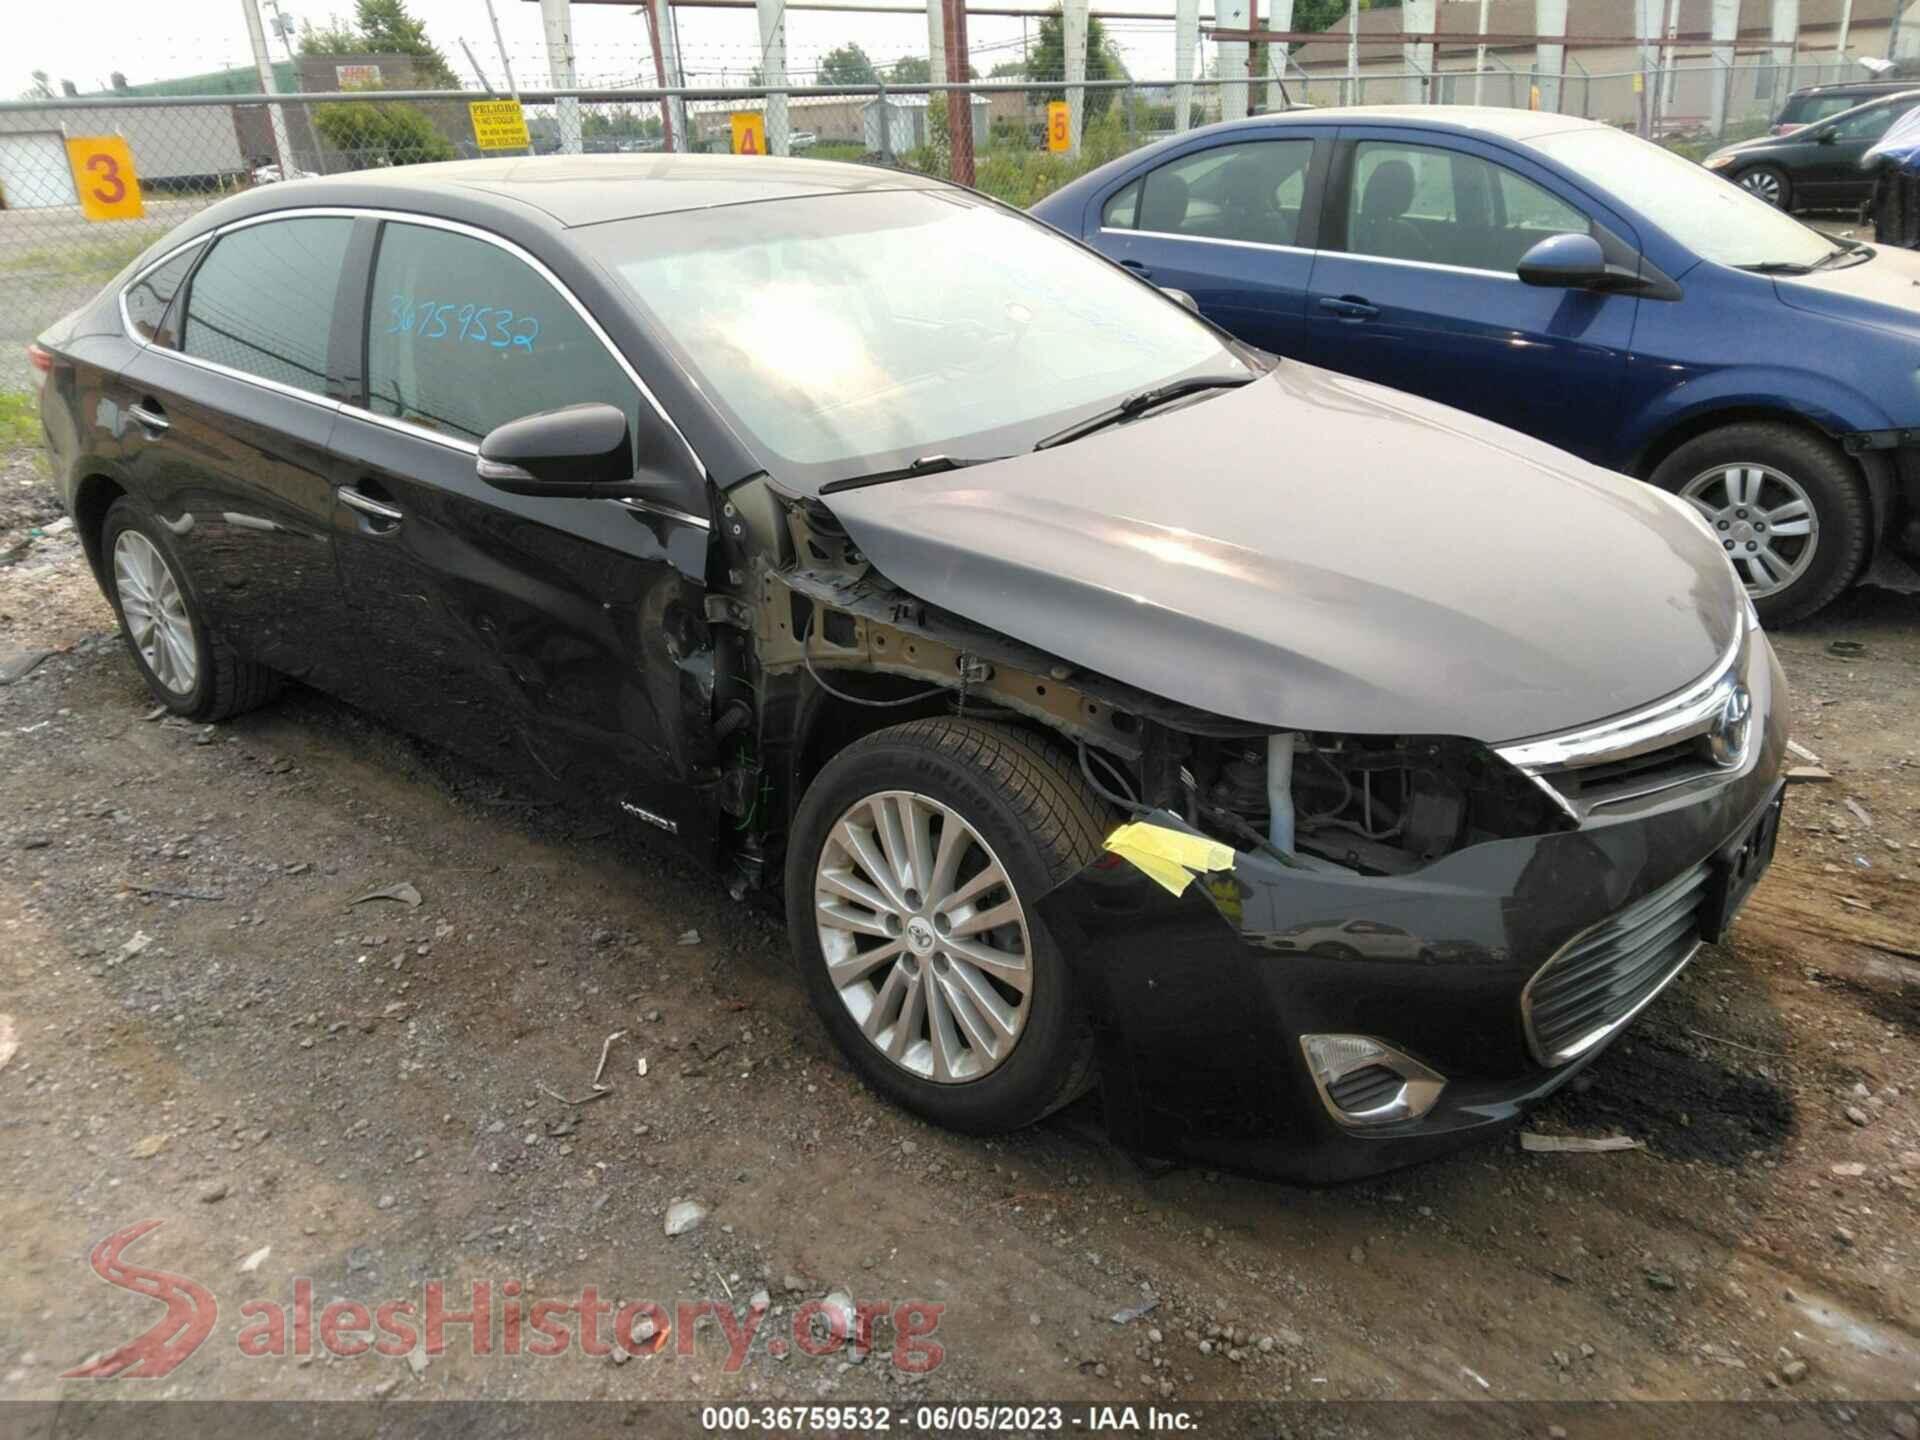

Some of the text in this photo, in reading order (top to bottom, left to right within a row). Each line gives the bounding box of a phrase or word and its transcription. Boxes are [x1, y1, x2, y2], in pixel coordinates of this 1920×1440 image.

[740, 127, 758, 154] 4
[1055, 112, 1065, 140] 5
[86, 153, 126, 204] 3
[385, 293, 540, 353] 36759532
